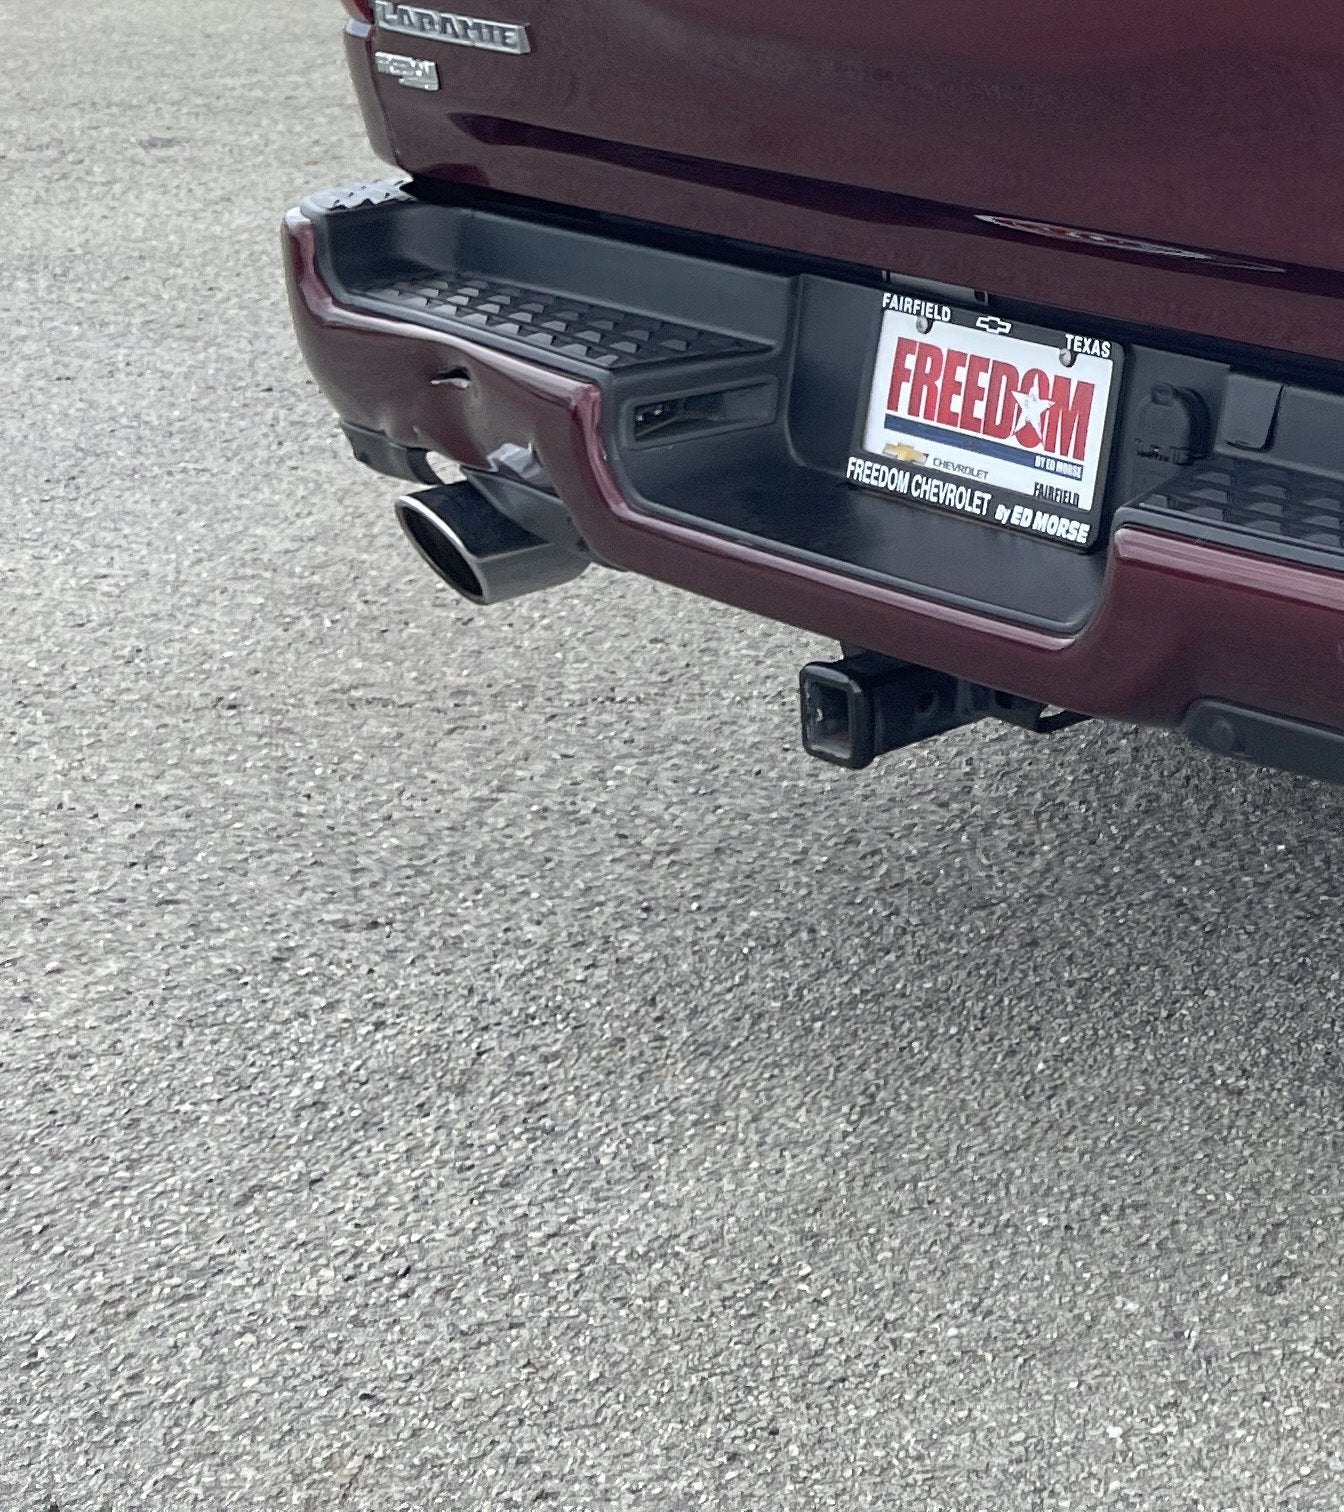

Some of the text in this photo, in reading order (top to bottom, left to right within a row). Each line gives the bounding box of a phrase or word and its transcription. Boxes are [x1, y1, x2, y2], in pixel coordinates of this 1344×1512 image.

[375, 0, 530, 54] LARAMIE
[882, 292, 1111, 358] FAIRFIELD TEXAS
[887, 336, 1096, 461] FREEDOM
[932, 457, 989, 479] CHEVROLET
[1033, 481, 1080, 507] FAIRFIELD
[1045, 457, 1055, 471] ED
[1055, 460, 1084, 480] MORSE
[846, 456, 911, 493] FREEDOM
[911, 473, 992, 516] CHEVROLET
[1011, 505, 1033, 527] ED
[1033, 510, 1091, 543] MORSE
